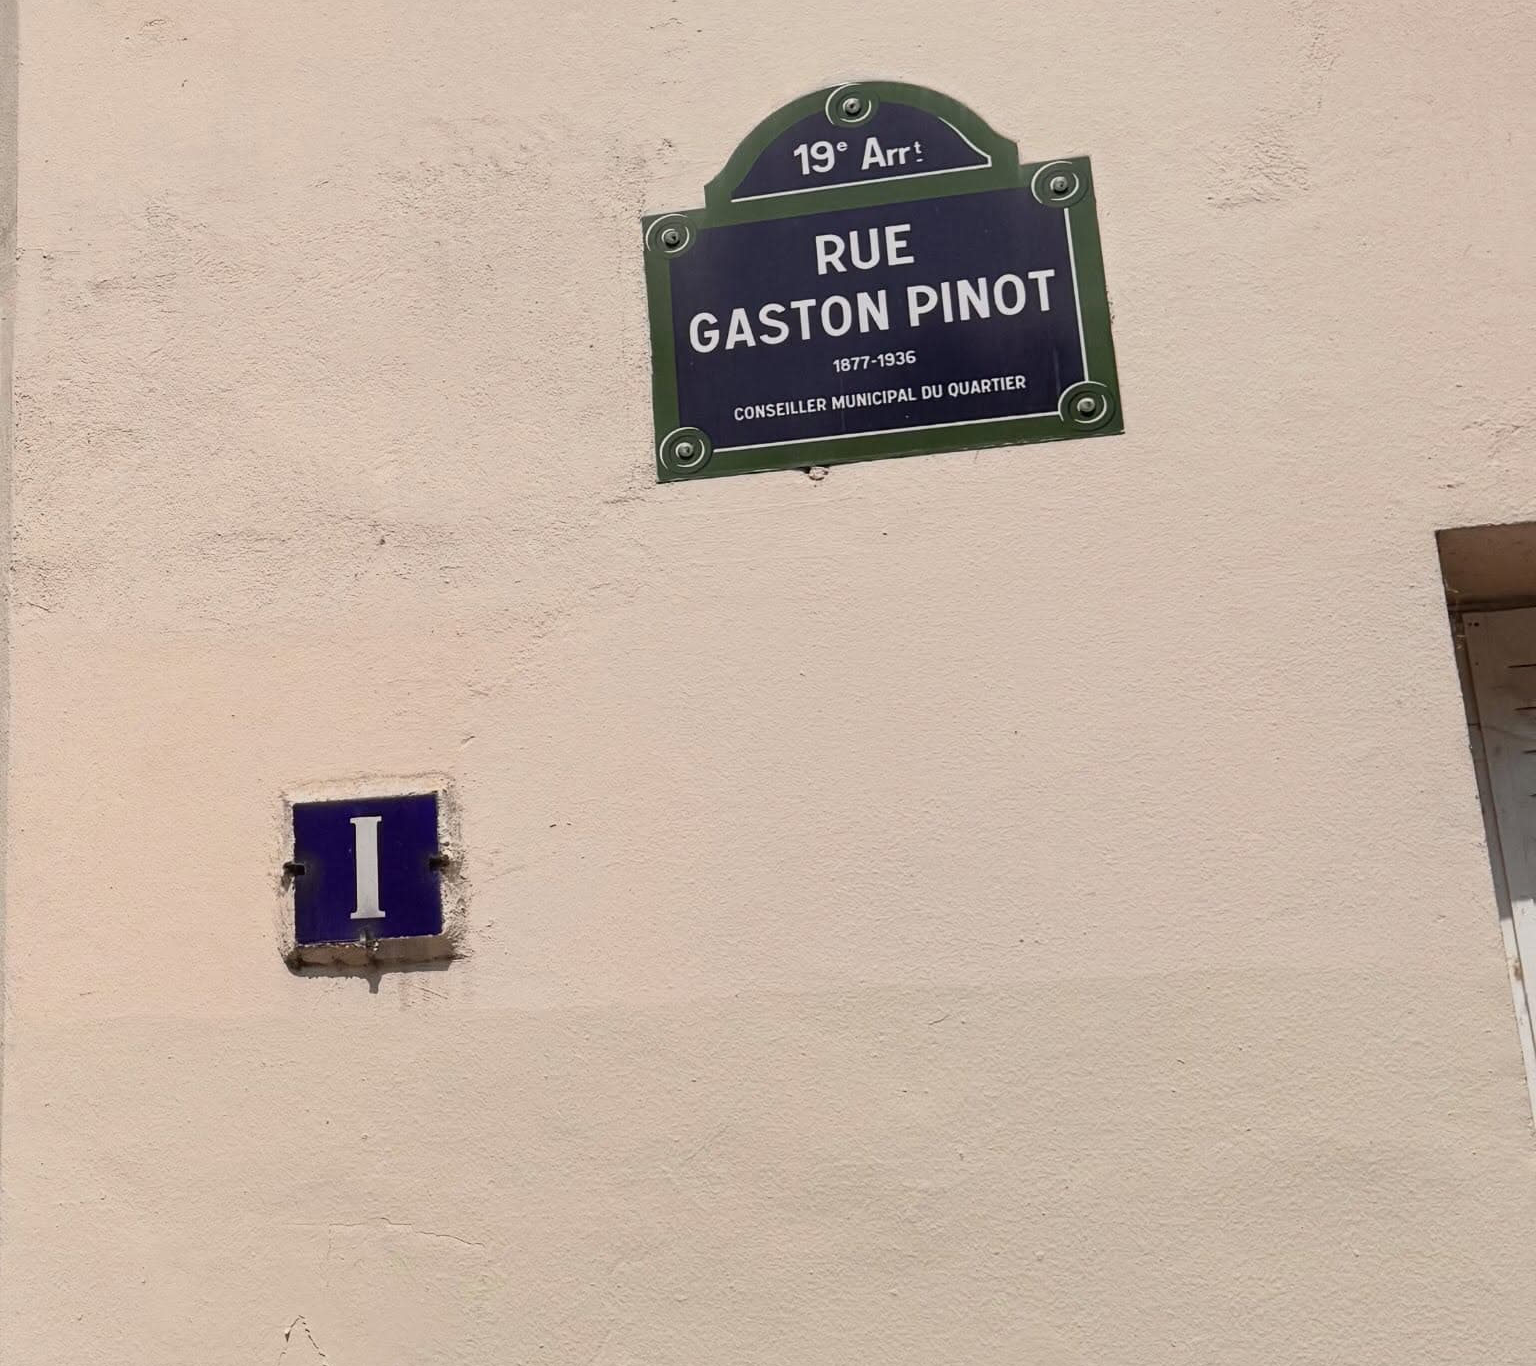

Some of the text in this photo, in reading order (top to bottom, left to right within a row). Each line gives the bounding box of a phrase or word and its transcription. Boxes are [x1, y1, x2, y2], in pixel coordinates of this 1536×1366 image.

[814, 223, 916, 276] RUE
[688, 268, 1057, 354] GASTON PINOT
[832, 350, 917, 373] 1877-1936
[733, 374, 1027, 422] CONSEILLER MUNICIPAL DU QUARTIER
